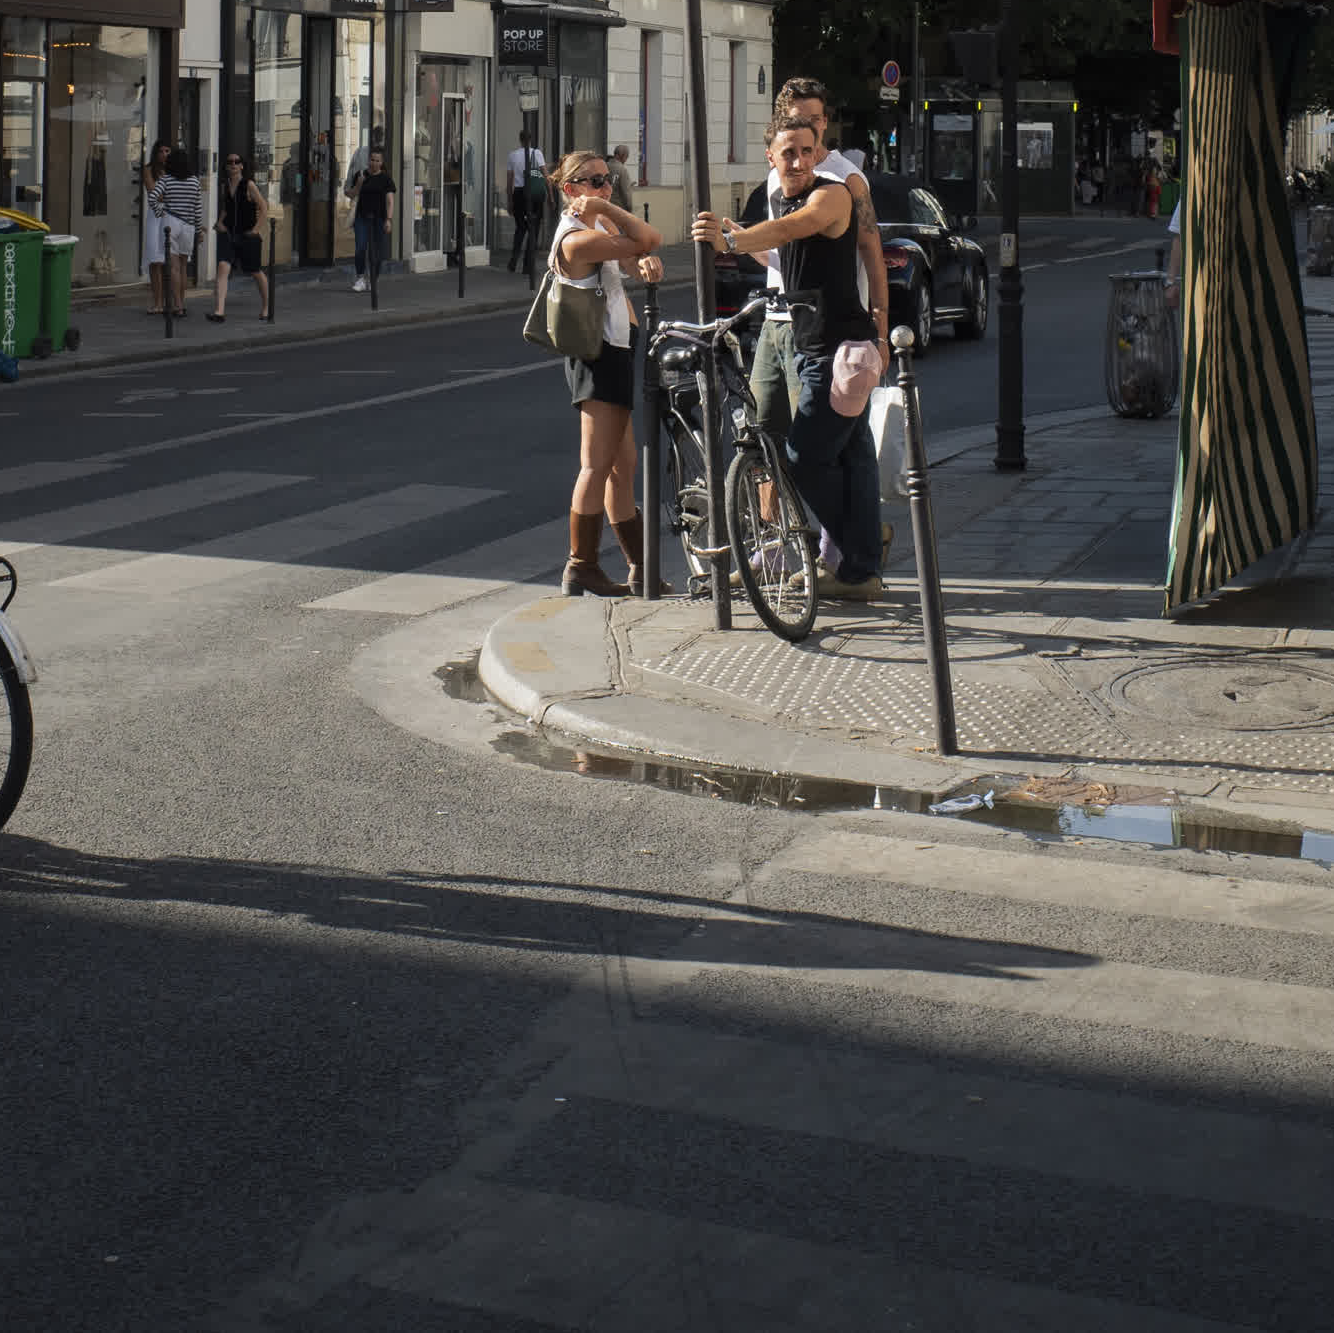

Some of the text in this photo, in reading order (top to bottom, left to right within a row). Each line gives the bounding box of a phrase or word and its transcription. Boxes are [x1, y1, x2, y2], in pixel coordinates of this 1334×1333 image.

[503, 29, 544, 40] POP UP
[503, 40, 545, 51] STORE
